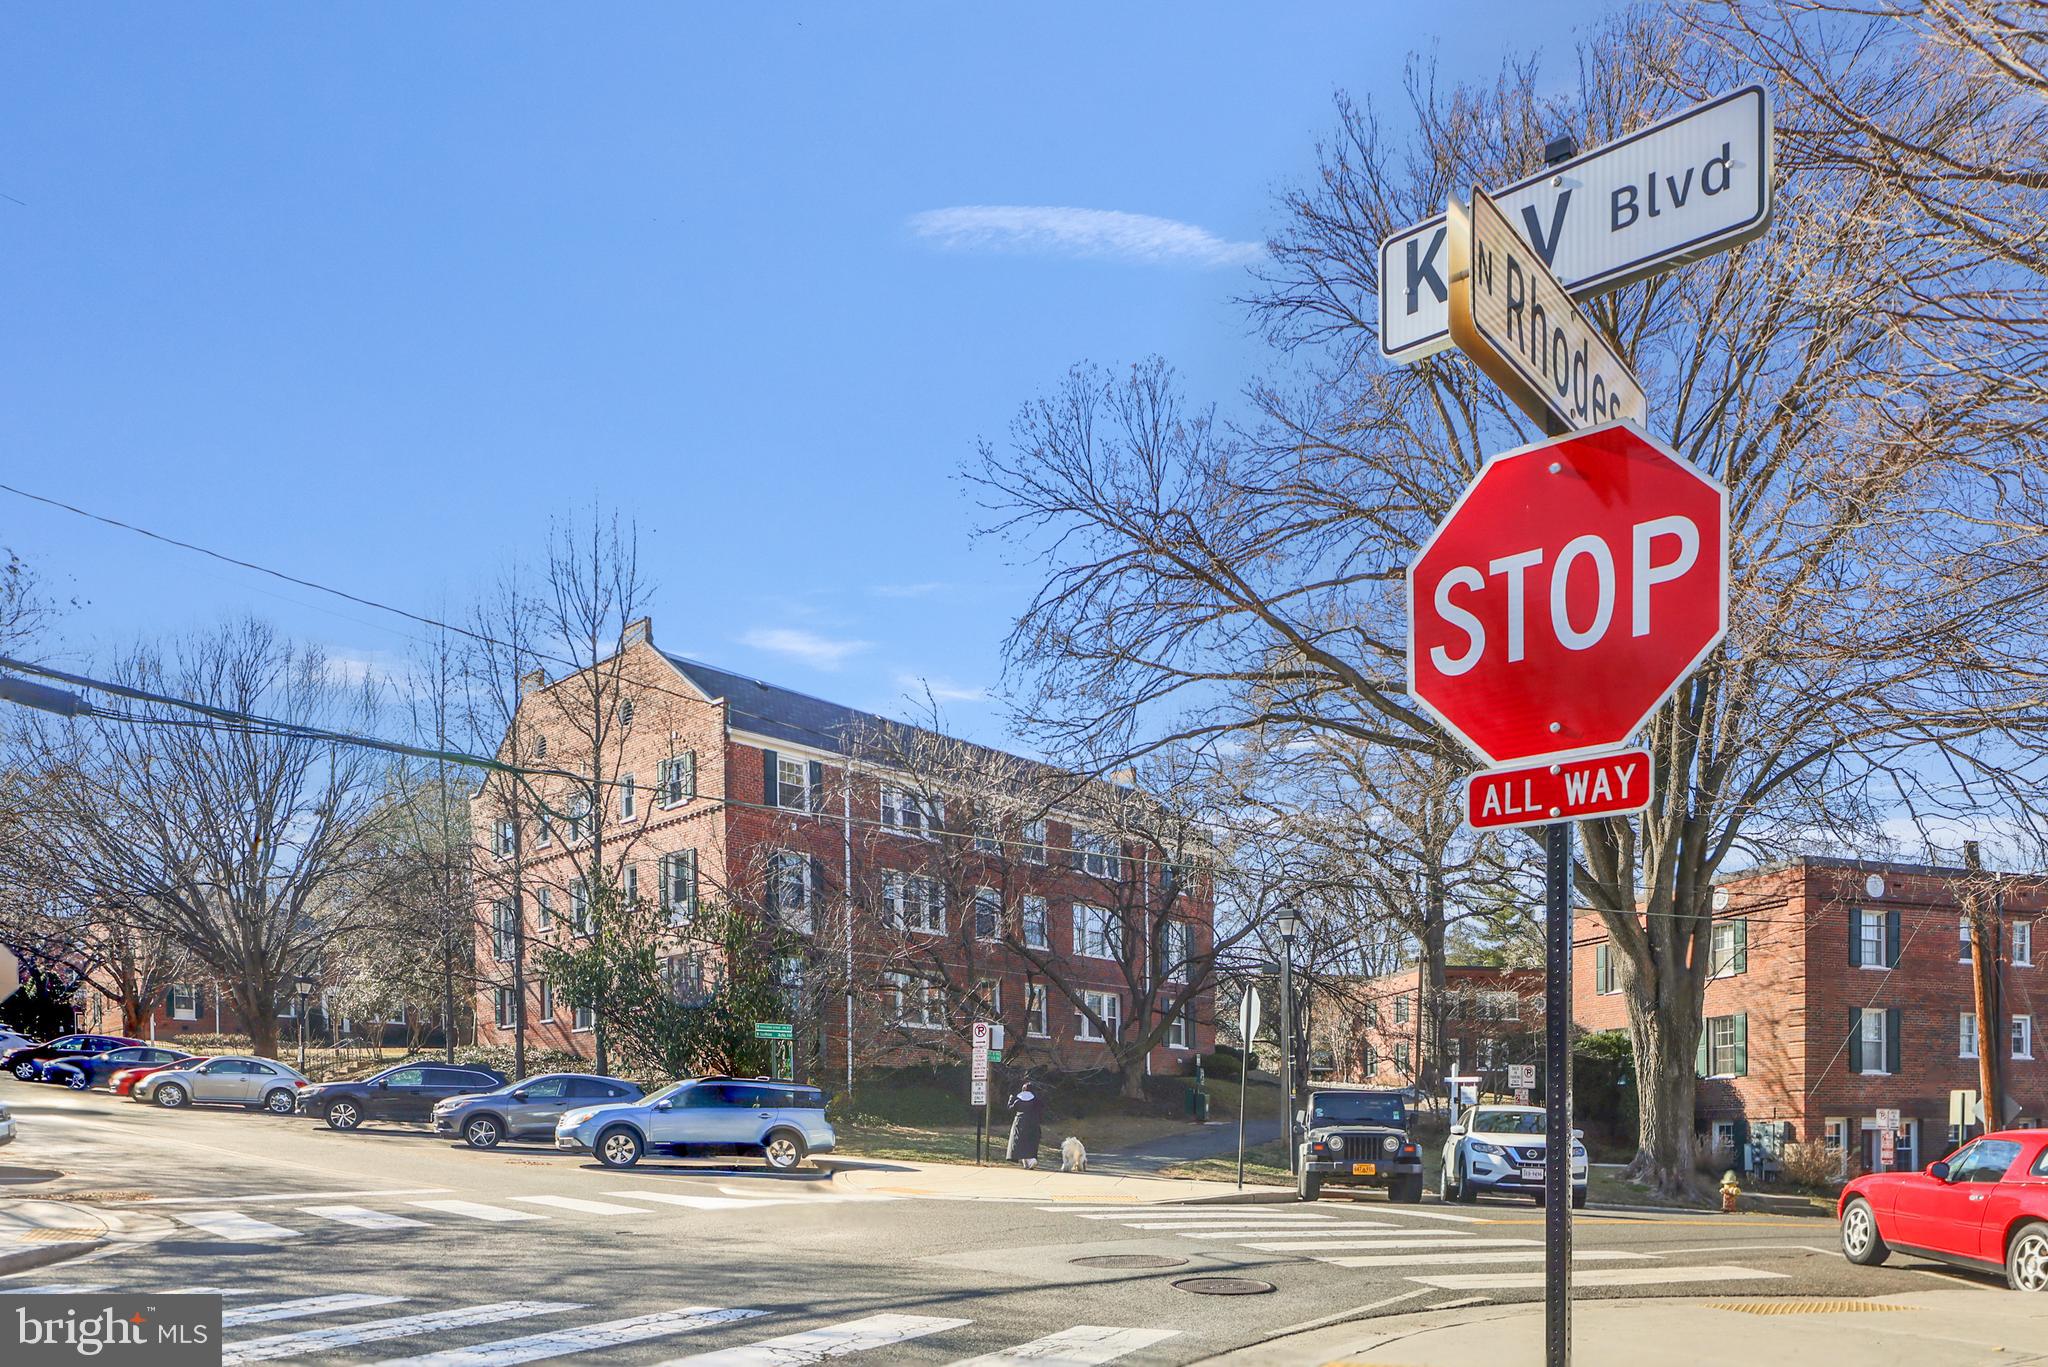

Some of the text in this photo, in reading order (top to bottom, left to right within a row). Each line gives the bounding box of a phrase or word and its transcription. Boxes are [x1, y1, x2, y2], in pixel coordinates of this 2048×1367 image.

[1611, 141, 1731, 233] Blvd
[1478, 239, 1493, 297] N
[1430, 515, 1700, 676] STOP
[1481, 763, 1637, 818] ALL WAY
